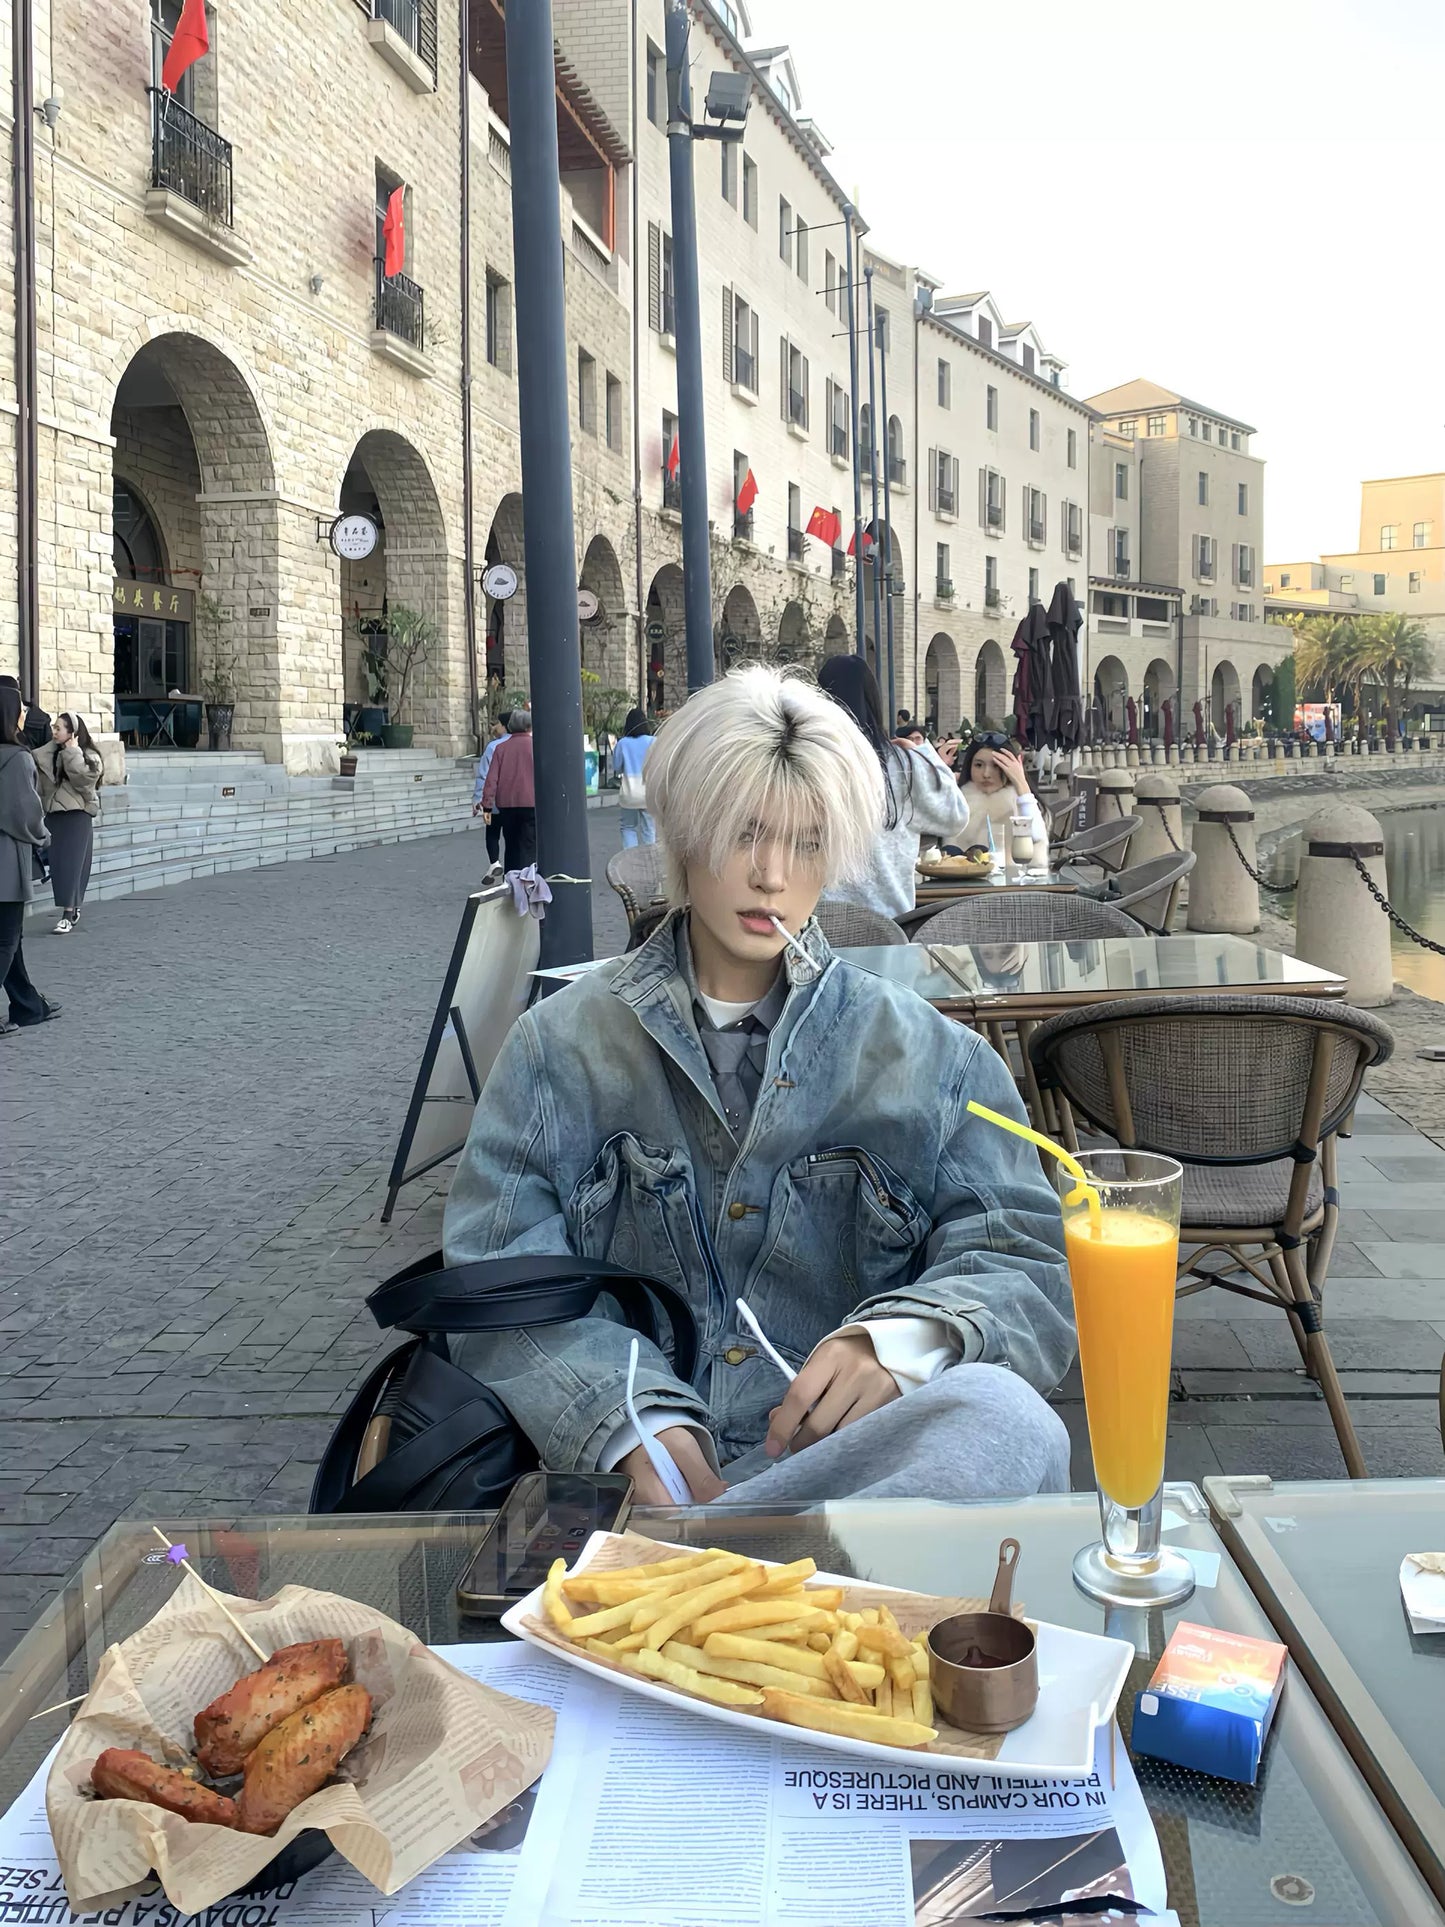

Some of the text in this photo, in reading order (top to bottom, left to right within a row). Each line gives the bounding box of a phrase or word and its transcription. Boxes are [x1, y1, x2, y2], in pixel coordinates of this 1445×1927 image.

[784, 1770, 931, 1790] PICTURESQUE
[936, 1774, 981, 1791] AND
[812, 1791, 1106, 1811] IN OUR CAMPUS, THERE IS A
[133, 1903, 157, 1926] A
[155, 1905, 181, 1927] IS
